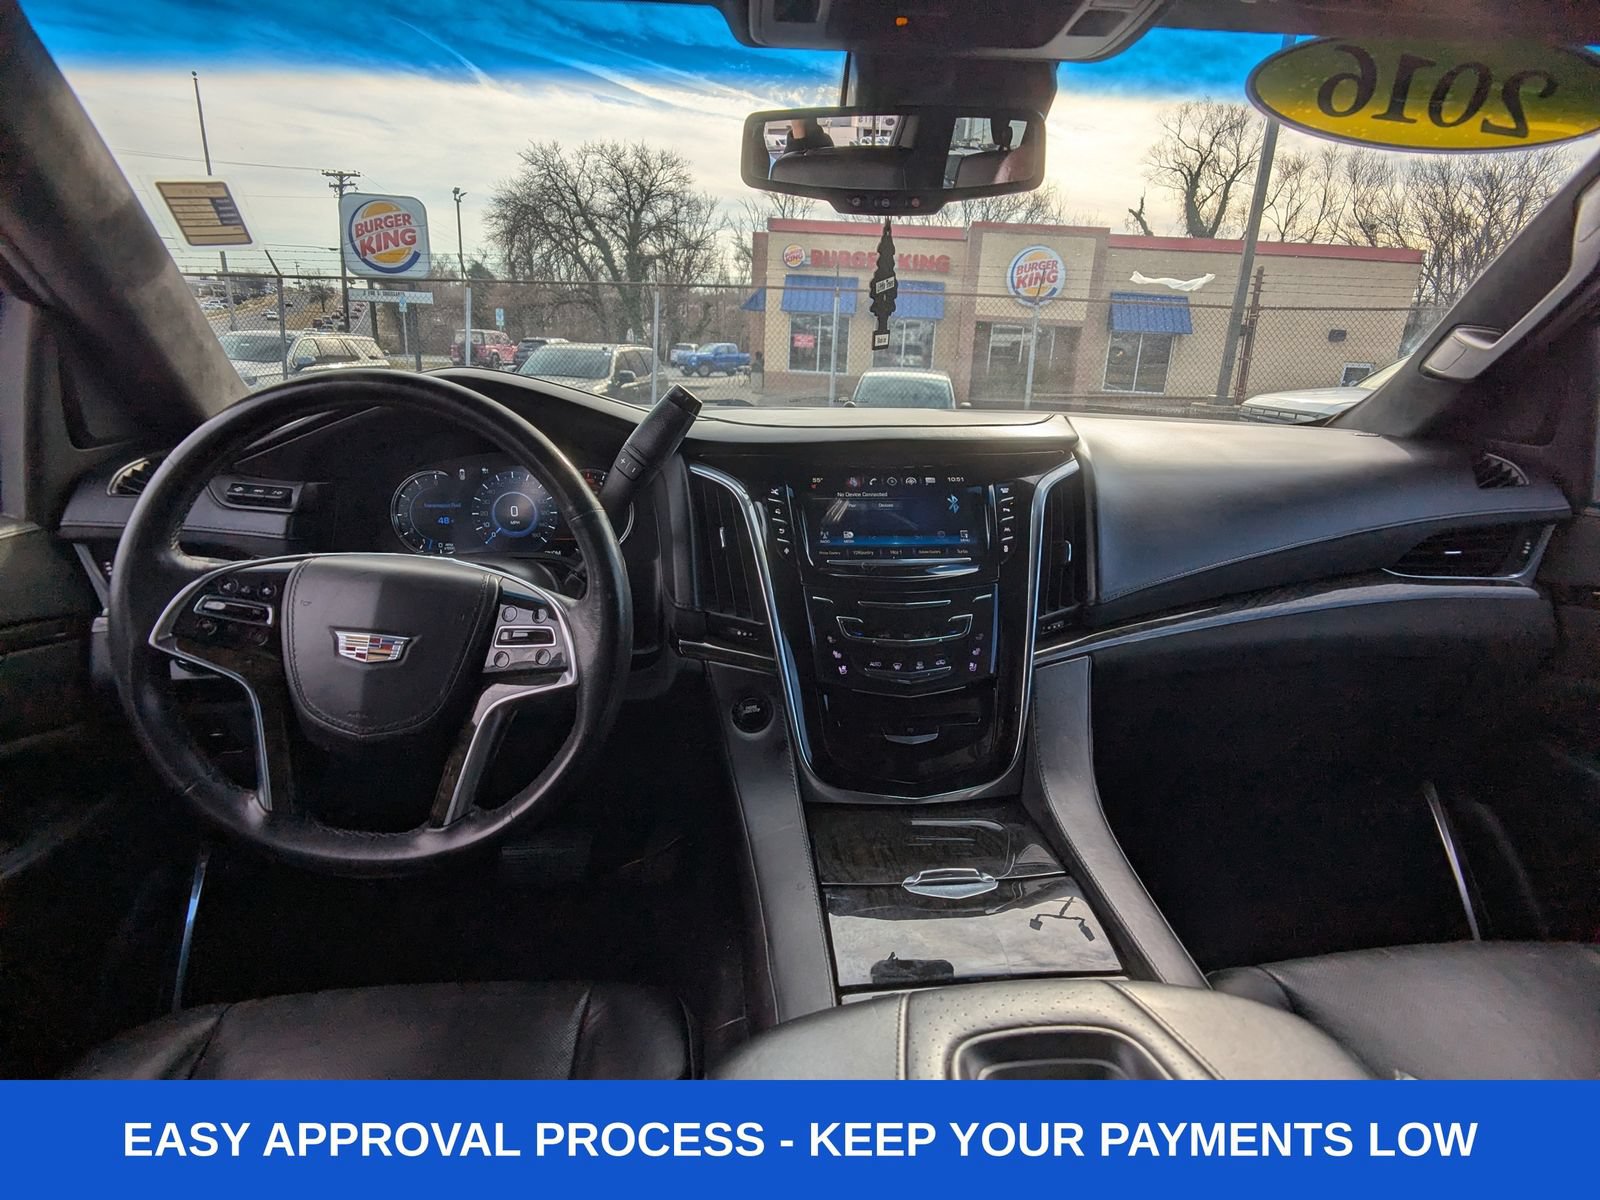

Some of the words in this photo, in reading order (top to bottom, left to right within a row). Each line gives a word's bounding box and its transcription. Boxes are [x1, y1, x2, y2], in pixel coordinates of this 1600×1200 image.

[355, 213, 412, 238] BURGER
[359, 228, 417, 257] KING
[811, 249, 878, 269] BURGE
[898, 253, 951, 272] KING
[1016, 259, 1058, 276] BURGER
[1015, 269, 1058, 289] KING
[510, 505, 519, 517] 0
